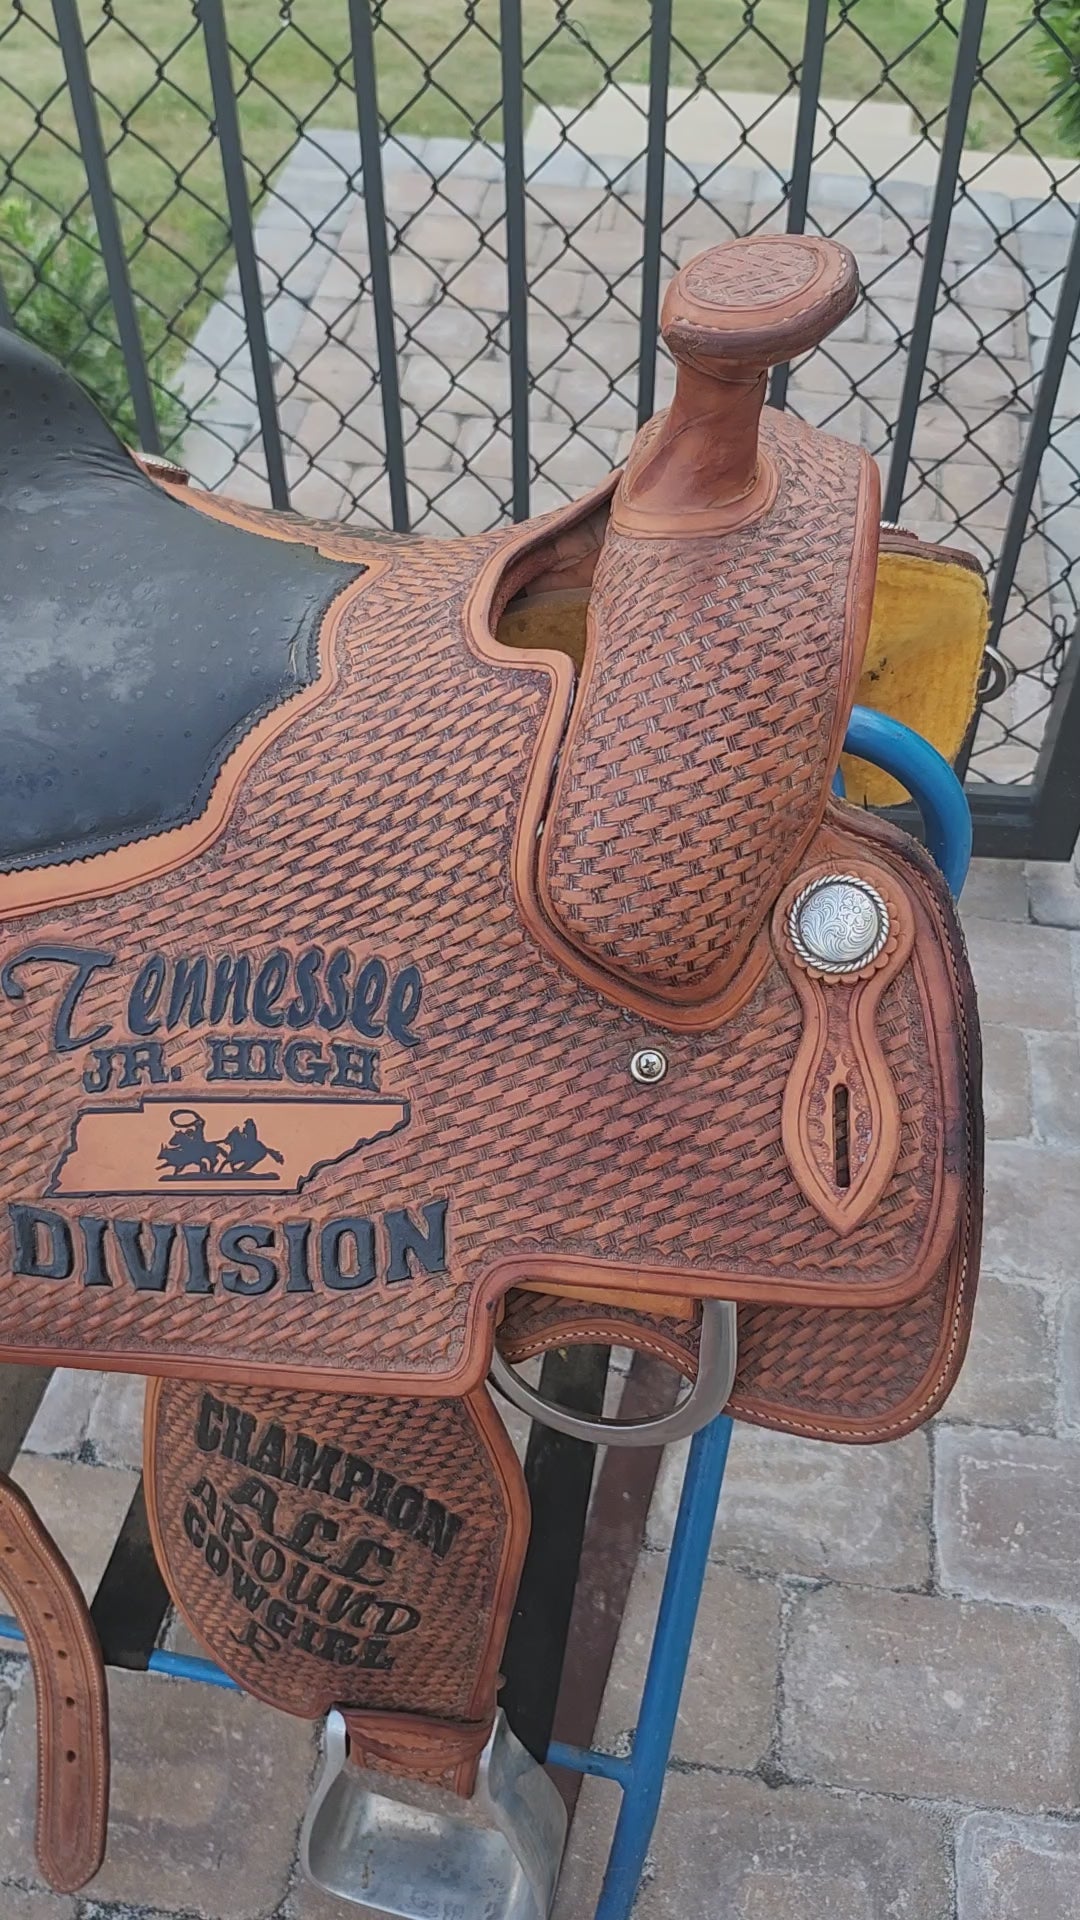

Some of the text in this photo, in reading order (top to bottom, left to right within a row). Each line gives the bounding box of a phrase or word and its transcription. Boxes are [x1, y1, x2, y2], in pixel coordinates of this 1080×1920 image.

[1, 944, 422, 1053] Tennessee
[83, 1036, 381, 1092] JR. HIGH
[8, 1200, 449, 1296] DIVISION
[195, 1394, 463, 1557] CHAMPION
[183, 1502, 397, 1670] COWGIRL
[191, 1477, 421, 1636] AROUND
[230, 1476, 396, 1586] ALL
